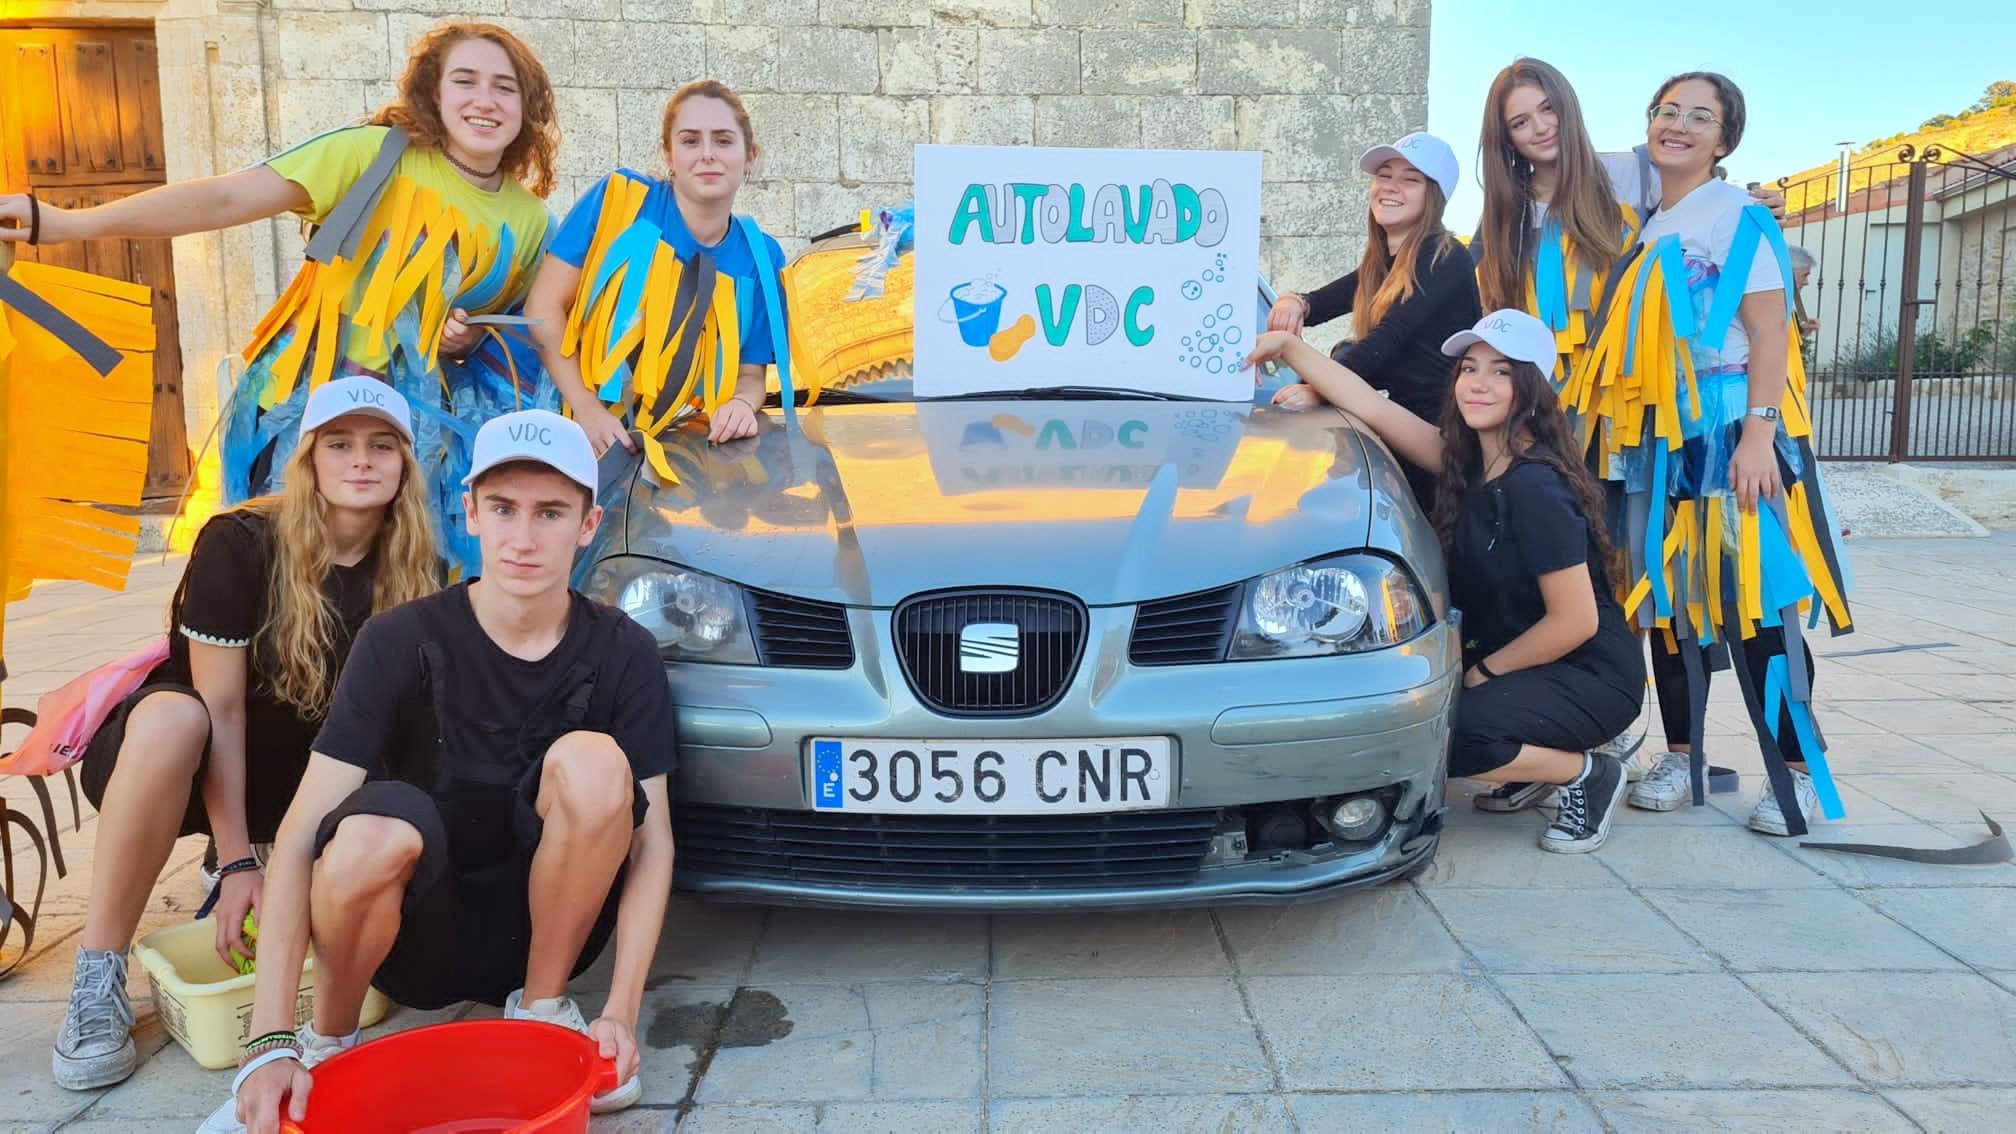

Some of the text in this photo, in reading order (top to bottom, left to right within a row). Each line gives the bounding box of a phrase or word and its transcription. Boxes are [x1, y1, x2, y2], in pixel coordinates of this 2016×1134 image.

[948, 178, 1229, 248] AUTOLAVADO
[1035, 283, 1155, 347] VDC
[347, 388, 385, 407] VDC
[508, 422, 552, 446] VDC
[823, 782, 836, 798] E
[848, 748, 1152, 803] 3056 CNR
